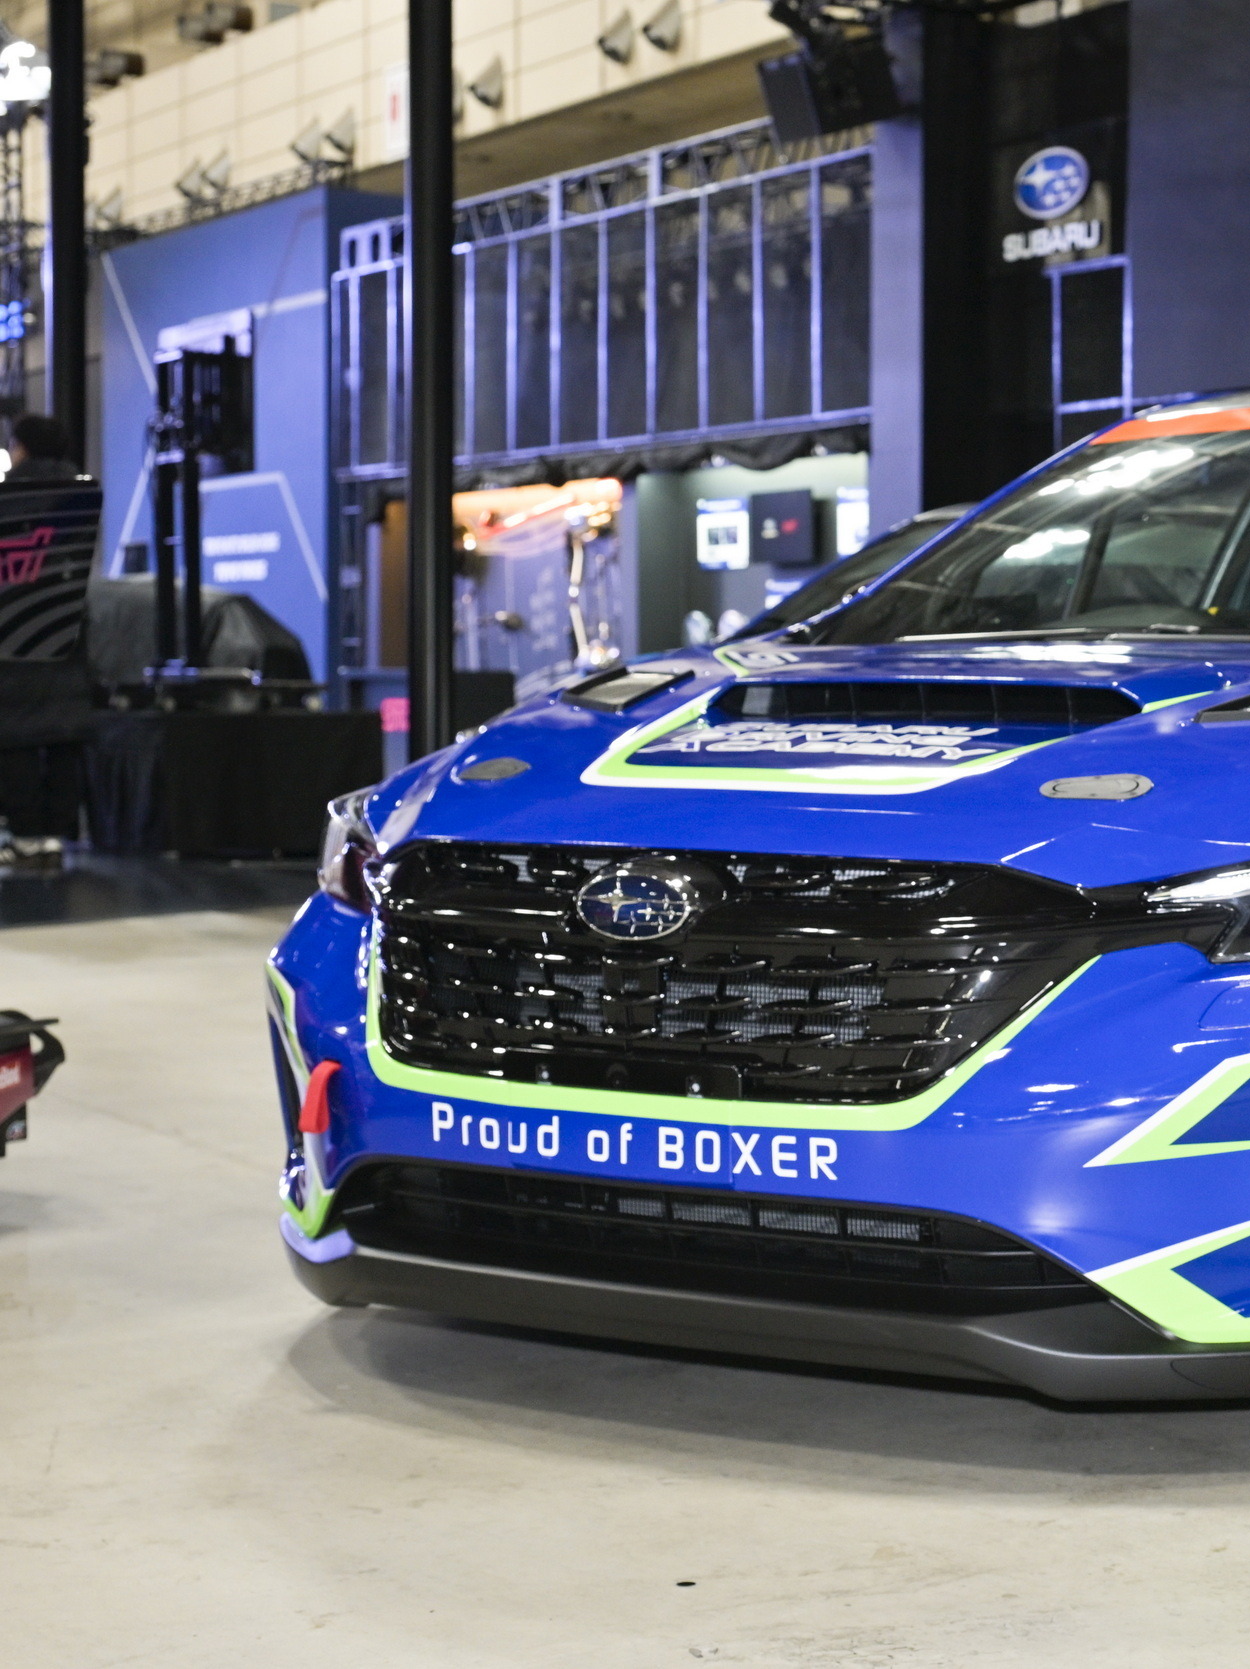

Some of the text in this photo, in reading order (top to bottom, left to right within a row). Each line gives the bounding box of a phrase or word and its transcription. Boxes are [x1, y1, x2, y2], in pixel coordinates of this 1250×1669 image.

[1002, 219, 1100, 262] SUBARU
[714, 721, 999, 736] SUBARU
[635, 740, 998, 761] ACADEMY
[431, 1101, 838, 1181] Proud of BOXER
